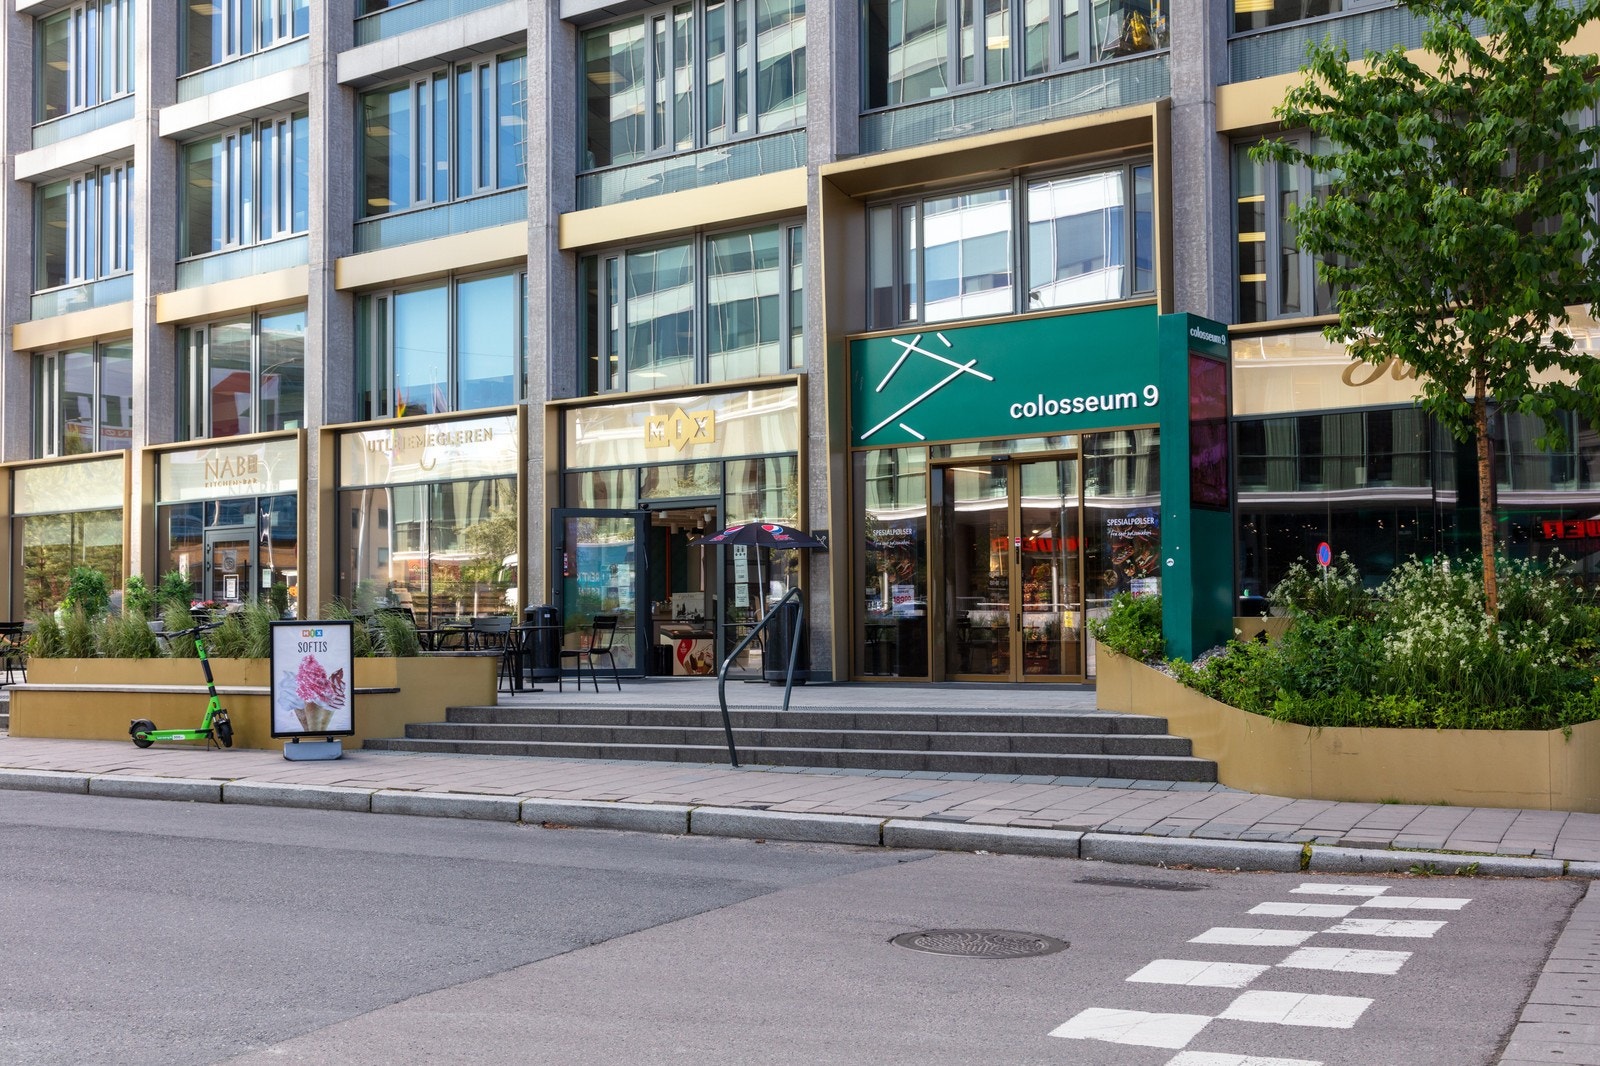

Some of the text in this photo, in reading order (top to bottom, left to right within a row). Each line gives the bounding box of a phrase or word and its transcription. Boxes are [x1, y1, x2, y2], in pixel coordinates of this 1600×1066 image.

[1190, 326, 1226, 346] colosseum 9
[1009, 384, 1160, 419] colosseum 9
[647, 414, 711, 444] MIX
[1106, 516, 1155, 527] SPESIALPØLSER
[872, 527, 913, 537] SPESIALPØLSER
[303, 628, 323, 638] MIX
[297, 641, 328, 653] SOFTIS
